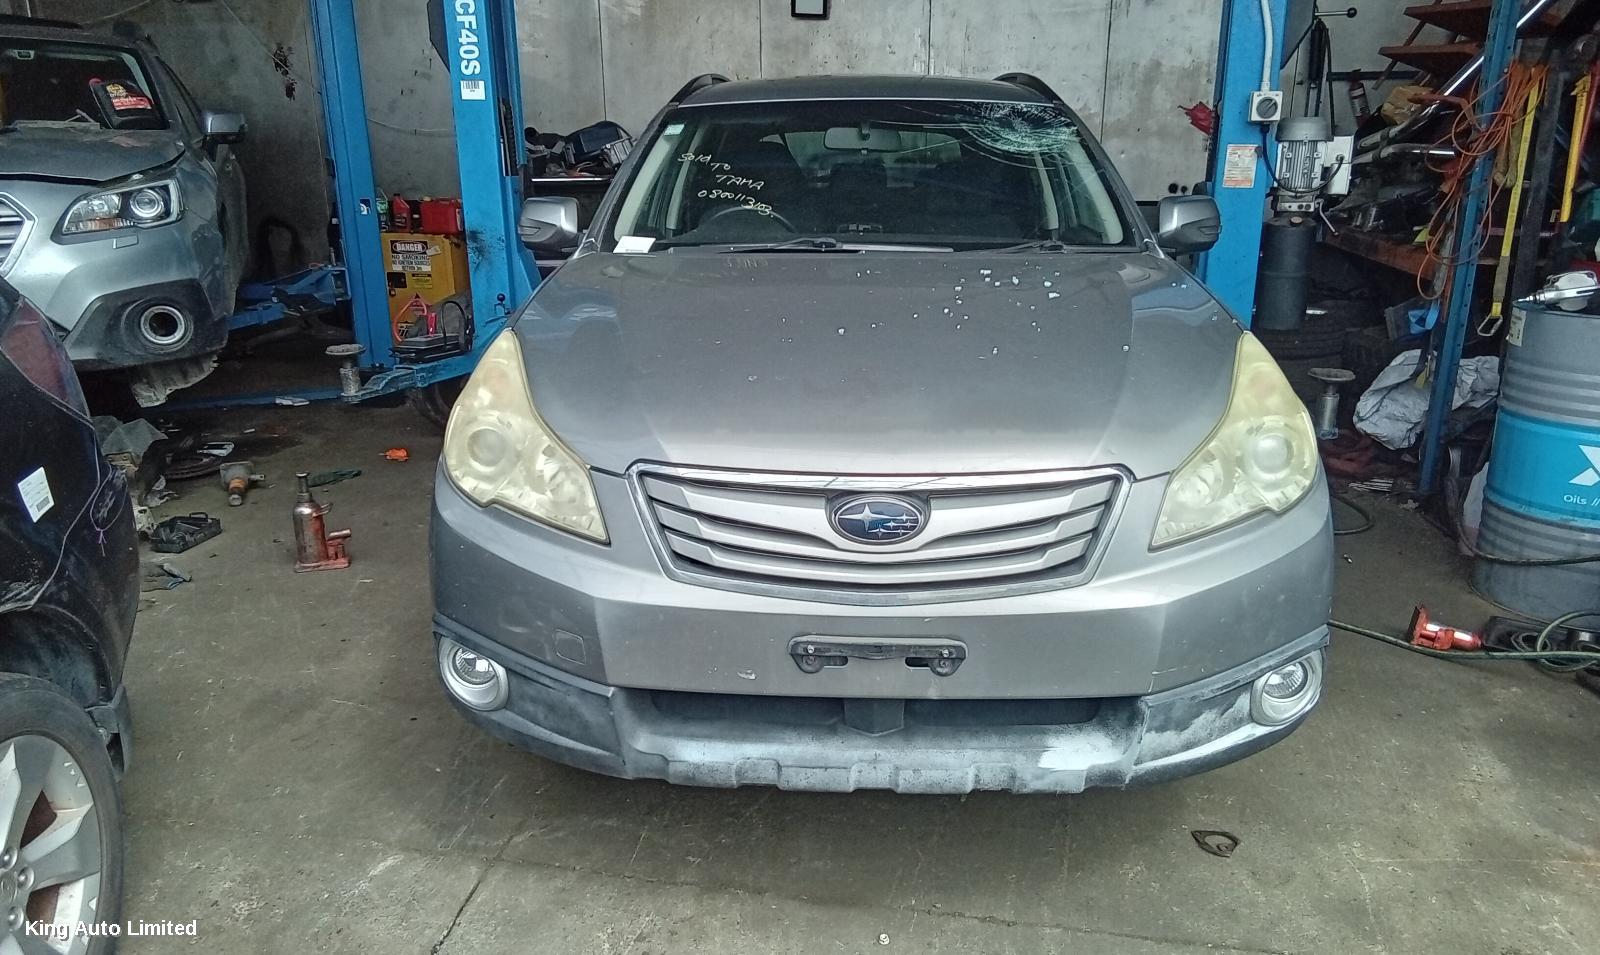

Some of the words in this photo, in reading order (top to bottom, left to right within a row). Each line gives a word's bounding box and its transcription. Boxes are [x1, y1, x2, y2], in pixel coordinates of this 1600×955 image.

[455, 0, 480, 75] CF40S
[716, 174, 764, 190] TAMA
[396, 243, 423, 252] DANGER
[1563, 494, 1587, 505] Oils
